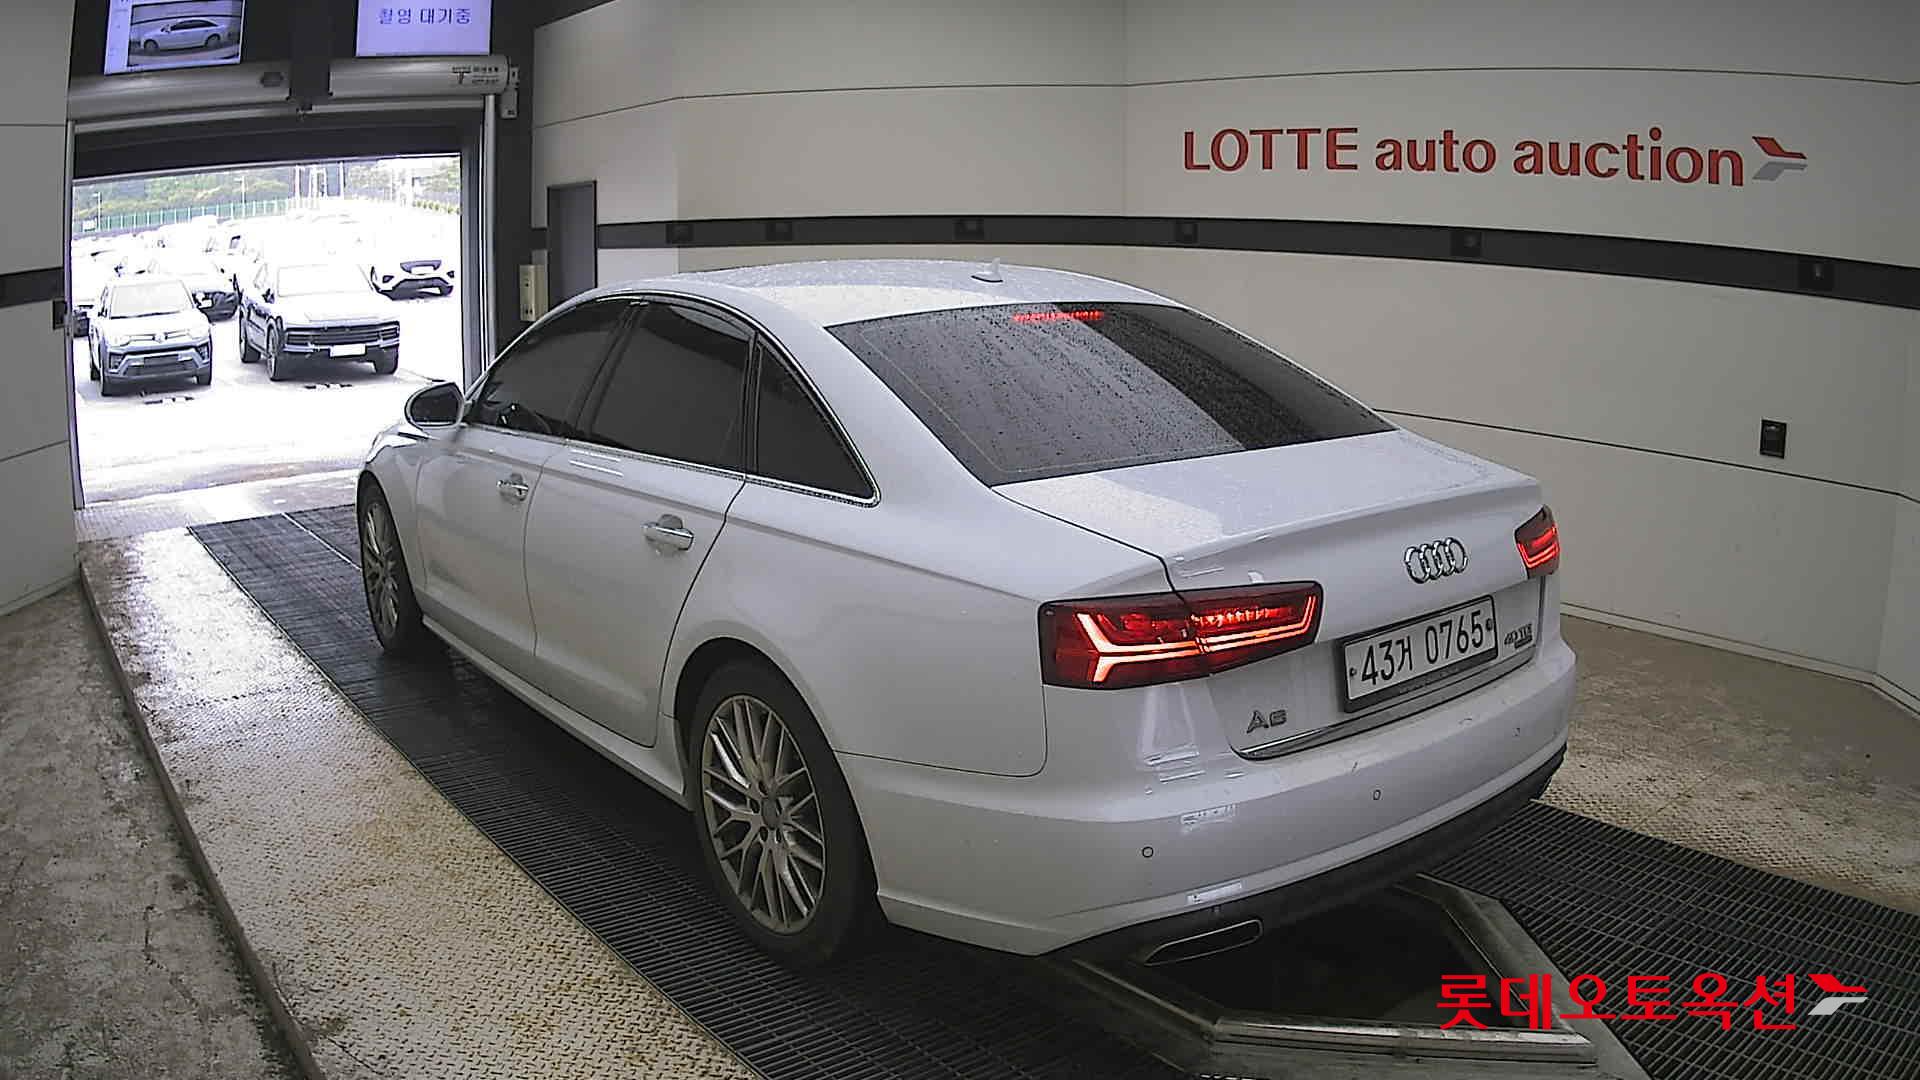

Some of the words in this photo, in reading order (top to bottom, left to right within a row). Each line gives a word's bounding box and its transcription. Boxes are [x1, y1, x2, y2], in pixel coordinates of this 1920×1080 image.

[419, 7, 472, 25] 대기중
[1185, 128, 1359, 171] LOTTE
[1376, 130, 1498, 173] auto
[1513, 127, 1744, 187] auction
[1361, 635, 1413, 686] 43거
[1425, 609, 1484, 665] 0765
[1246, 709, 1287, 734] A6
